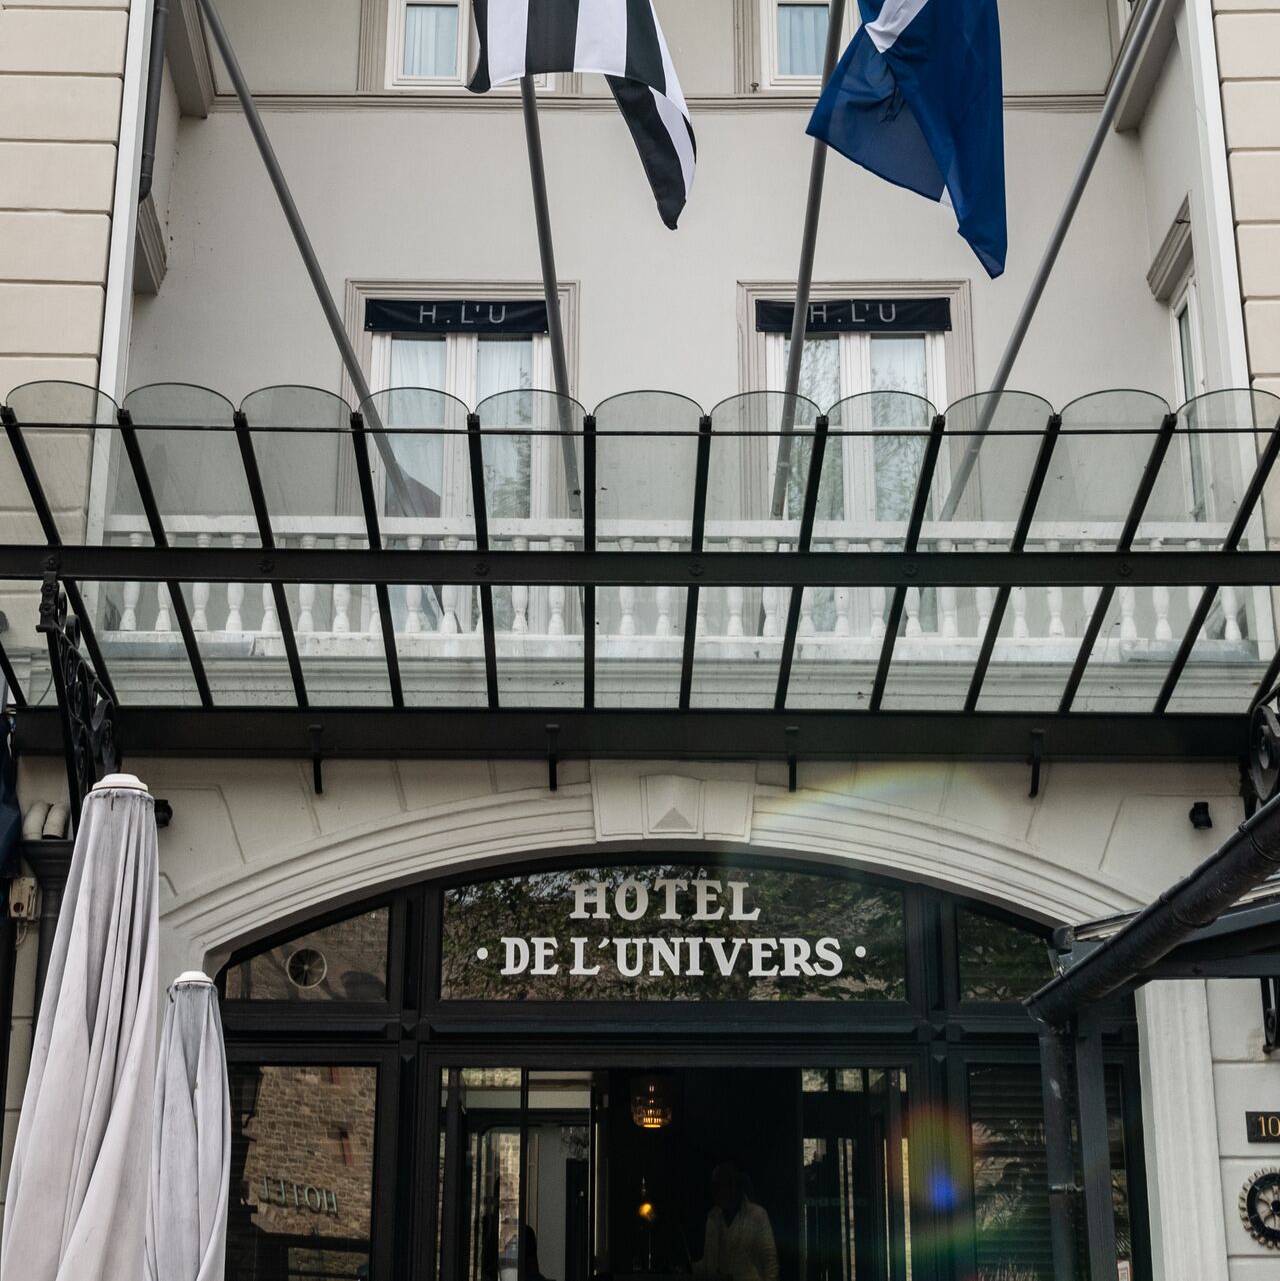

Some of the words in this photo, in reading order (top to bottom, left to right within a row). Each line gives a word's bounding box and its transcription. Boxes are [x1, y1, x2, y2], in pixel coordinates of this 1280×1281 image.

[569, 878, 761, 921] HOTEL
[500, 936, 559, 976] DE
[569, 936, 844, 978] L'UNIVERS
